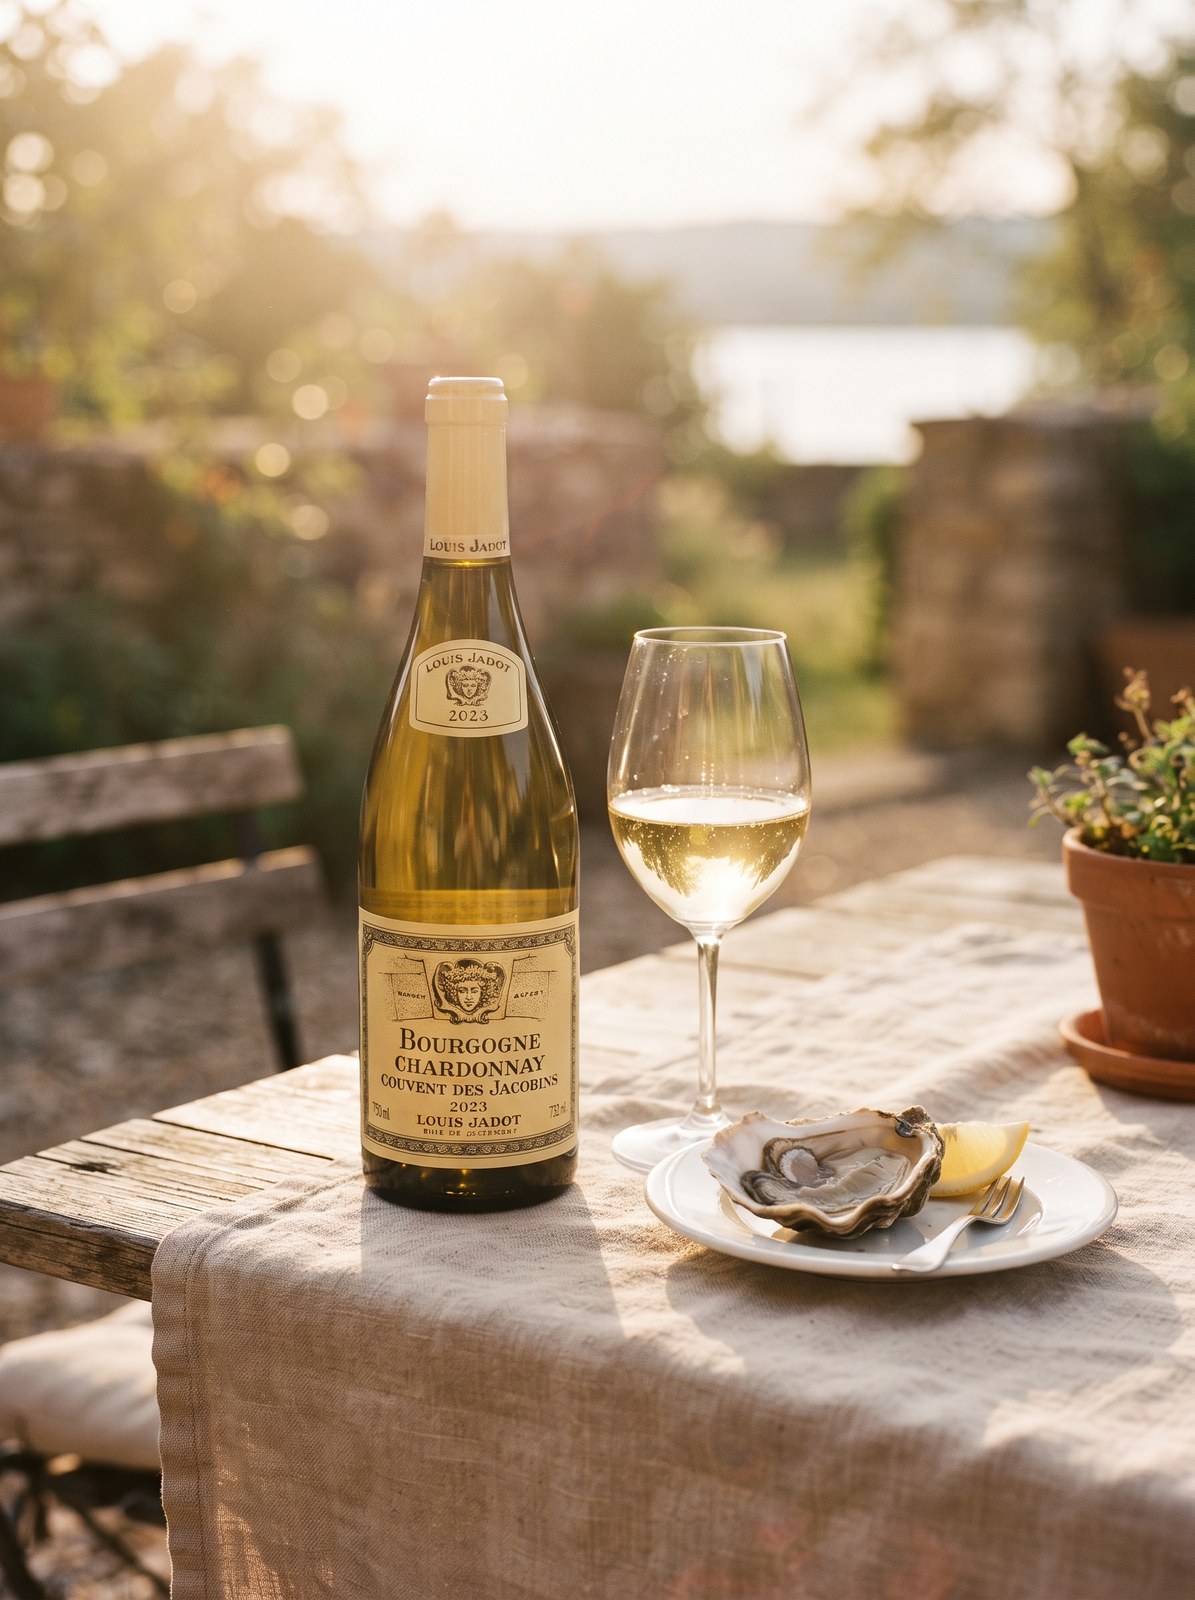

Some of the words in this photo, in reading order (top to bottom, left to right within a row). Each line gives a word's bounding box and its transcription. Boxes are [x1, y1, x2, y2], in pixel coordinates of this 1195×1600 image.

[429, 539, 465, 552] LOUIS
[469, 539, 506, 552] JADOT
[425, 654, 463, 673] LOUIS
[468, 653, 511, 673] JADOT
[449, 710, 488, 721] 2023
[400, 1028, 541, 1054] BOURGOGNE
[395, 1055, 546, 1077] CHARDONNAY
[381, 1073, 447, 1095] COUVENT
[453, 1084, 484, 1096] DES
[489, 1074, 558, 1096] JACOBINS
[450, 1101, 488, 1112] 2023
[416, 1114, 463, 1128] LOUIS
[468, 1114, 521, 1128] JADOT
